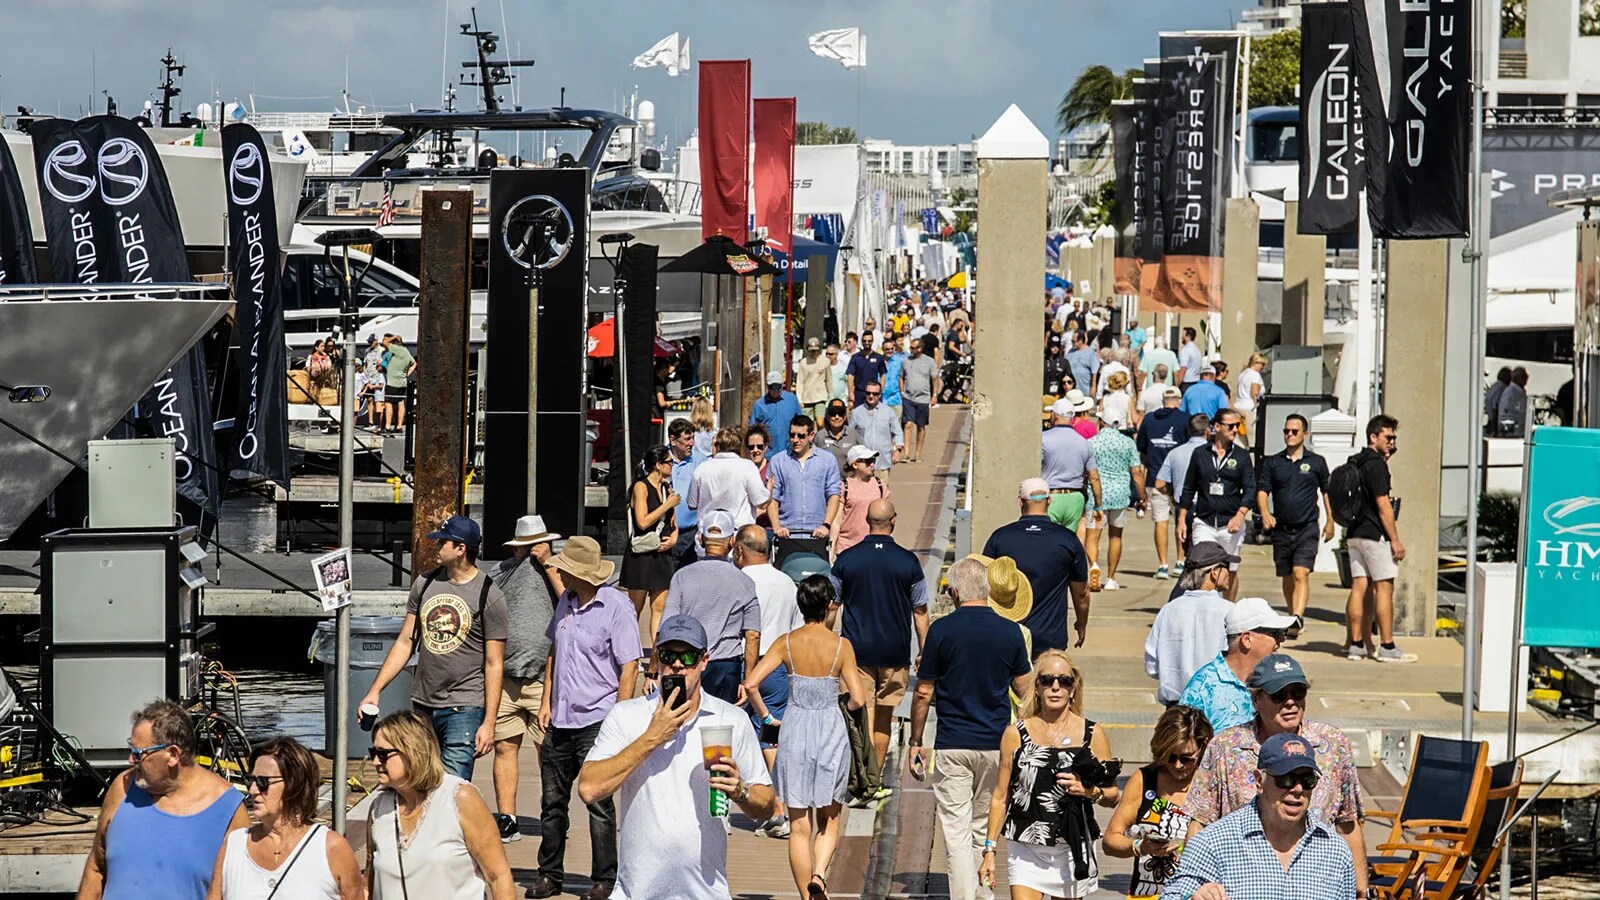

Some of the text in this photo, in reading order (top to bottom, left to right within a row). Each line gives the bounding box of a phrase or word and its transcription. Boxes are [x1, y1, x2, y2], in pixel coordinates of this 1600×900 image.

[1399, 0, 1431, 167] GAL
[1437, 0, 1455, 99] YAC
[1326, 43, 1349, 200] GALEON
[1534, 173, 1600, 194] PR
[245, 212, 266, 357] AXANDER
[781, 259, 809, 269] Dtail
